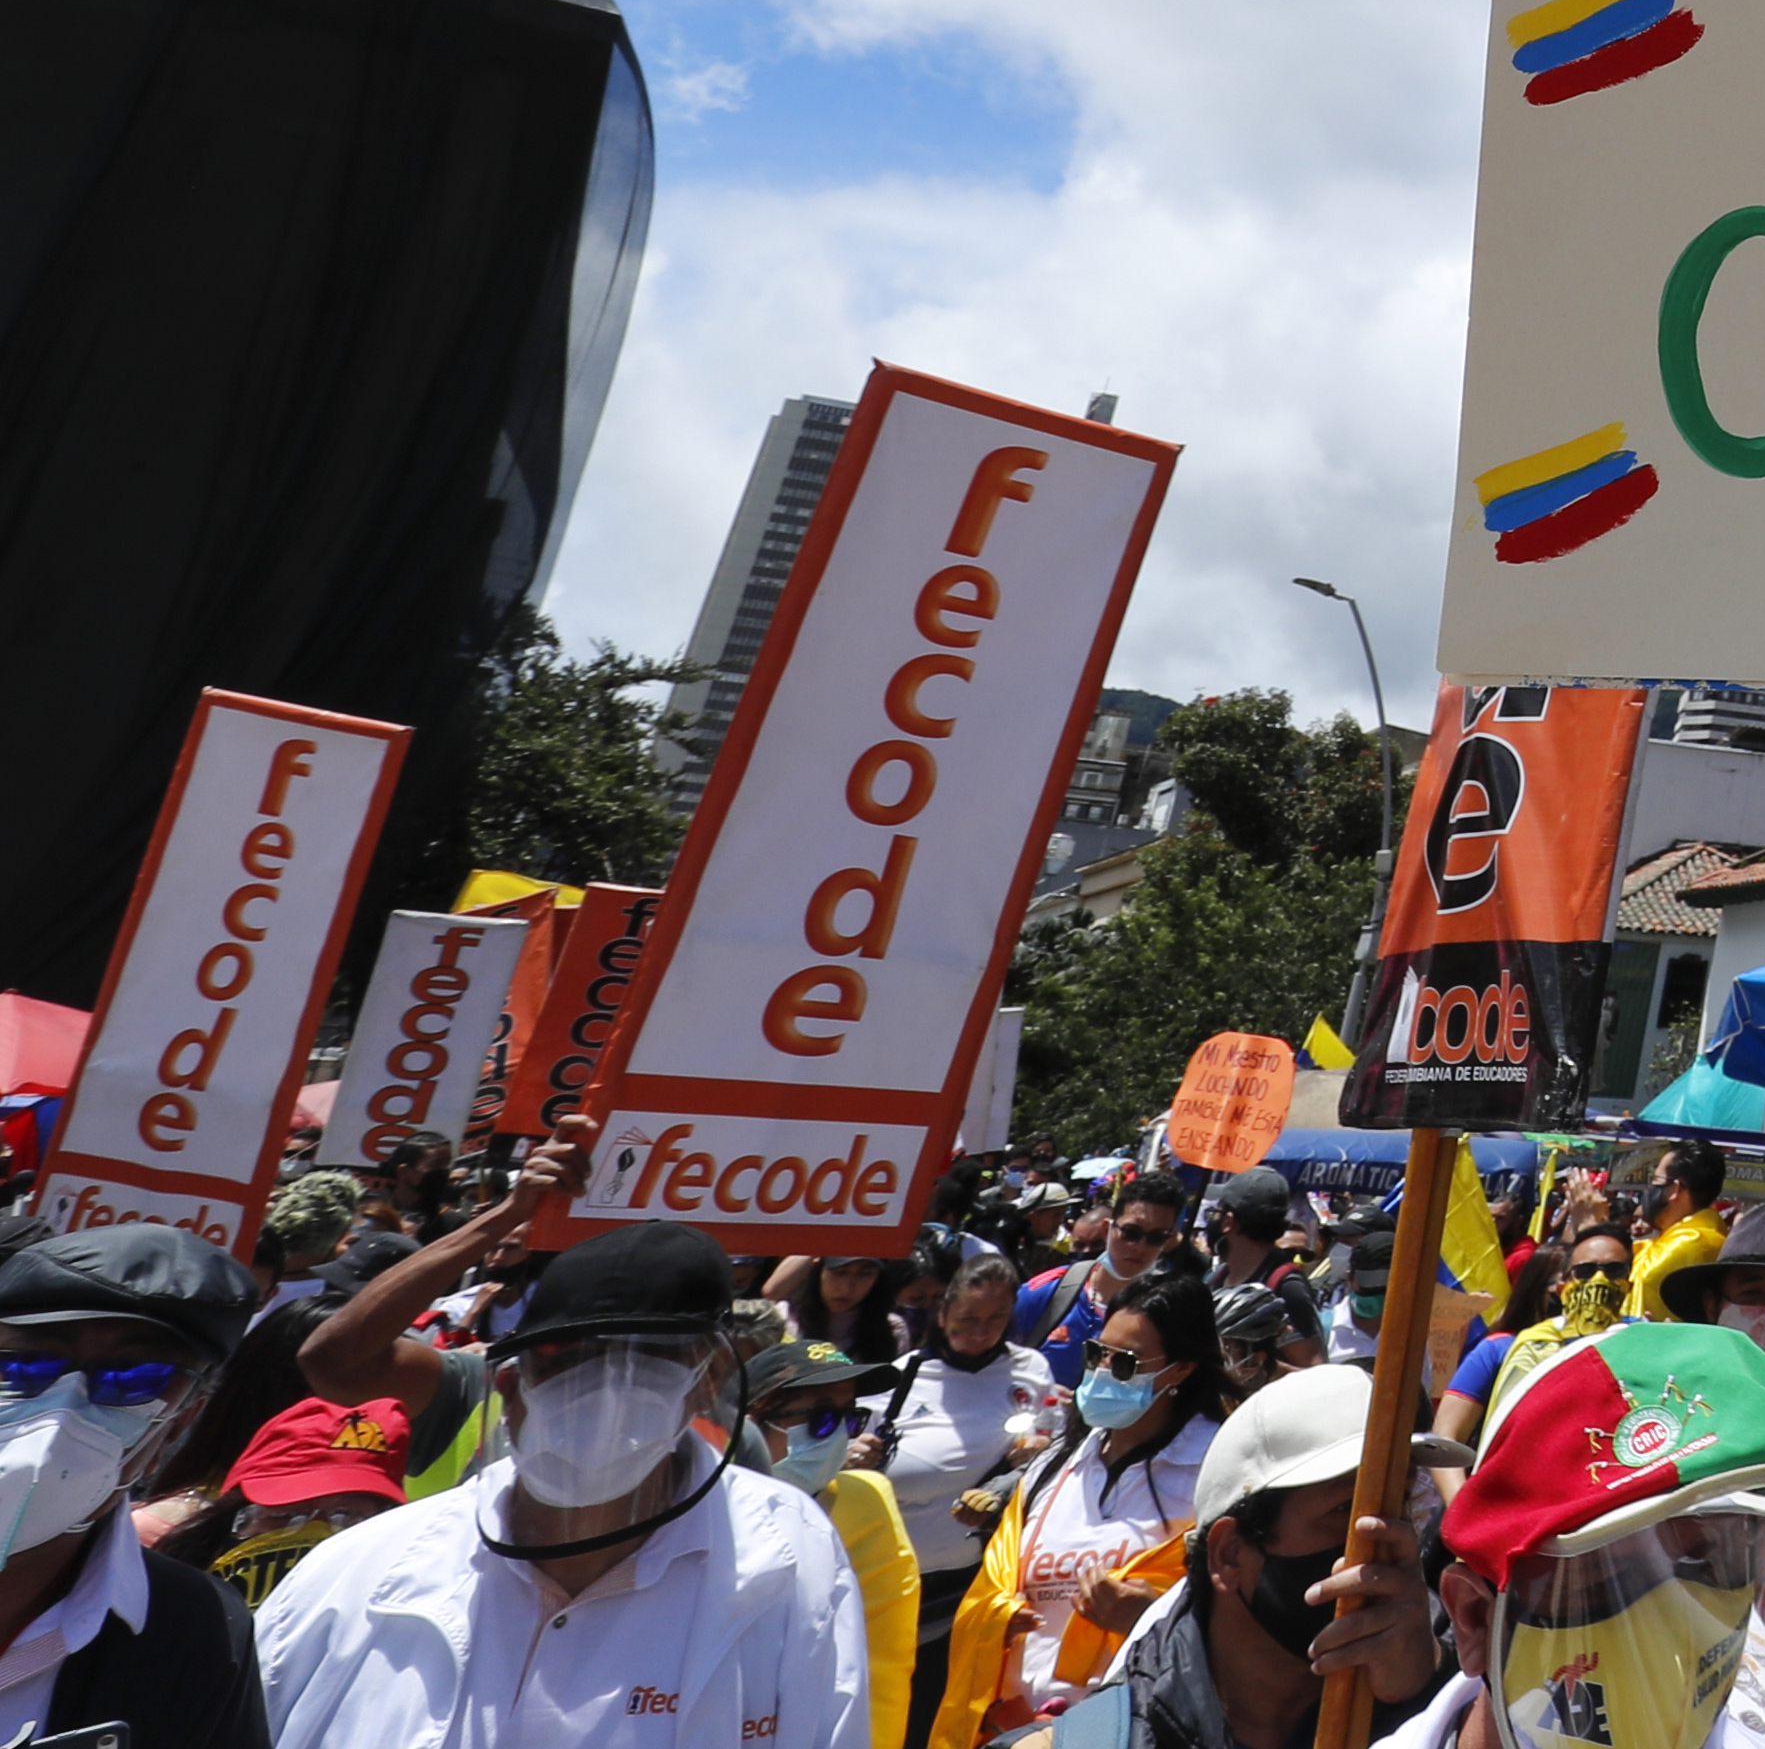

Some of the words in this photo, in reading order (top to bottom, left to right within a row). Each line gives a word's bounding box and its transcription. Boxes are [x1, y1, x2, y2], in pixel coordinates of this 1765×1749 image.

[761, 445, 1049, 1057] fecode
[137, 738, 318, 1152] fecode
[361, 927, 485, 1161] fecode
[1455, 1067, 1471, 1081] DE
[1473, 1066, 1528, 1082] EDUCADORES
[66, 1185, 229, 1247] fede
[628, 1122, 898, 1217] fecode
[1632, 1423, 1668, 1452] CRIC
